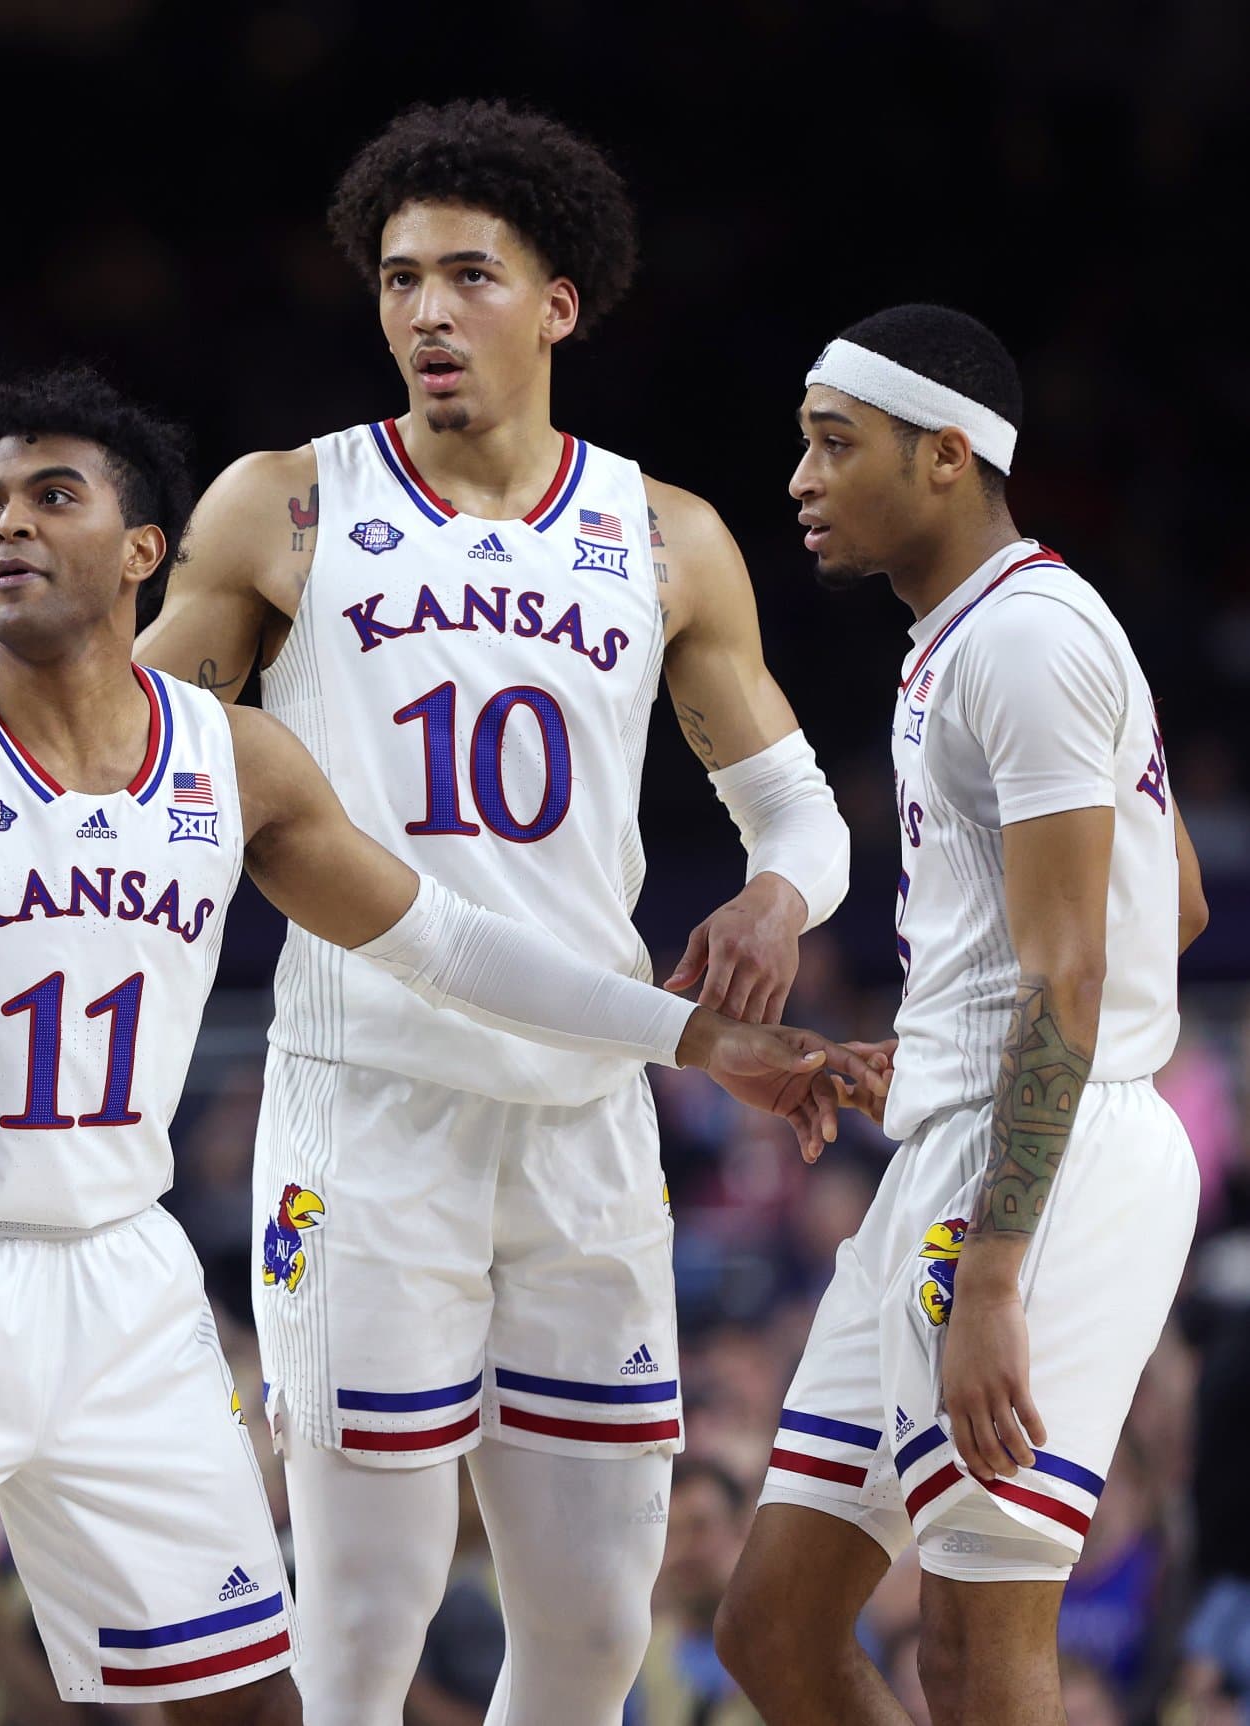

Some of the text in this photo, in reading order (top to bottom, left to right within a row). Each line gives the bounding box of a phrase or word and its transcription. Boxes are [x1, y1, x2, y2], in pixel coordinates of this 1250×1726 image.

[365, 534, 389, 543] FOUR
[366, 527, 389, 535] FINAL
[467, 549, 513, 563] adidas
[342, 584, 629, 672] KANSAS
[393, 681, 572, 844] 10
[76, 827, 118, 840] adidas
[990, 1012, 1091, 1234] BABY
[276, 1238, 291, 1262] KU
[620, 1362, 659, 1375] adidas
[895, 1419, 916, 1443] adidas
[218, 1582, 260, 1602] adidas
